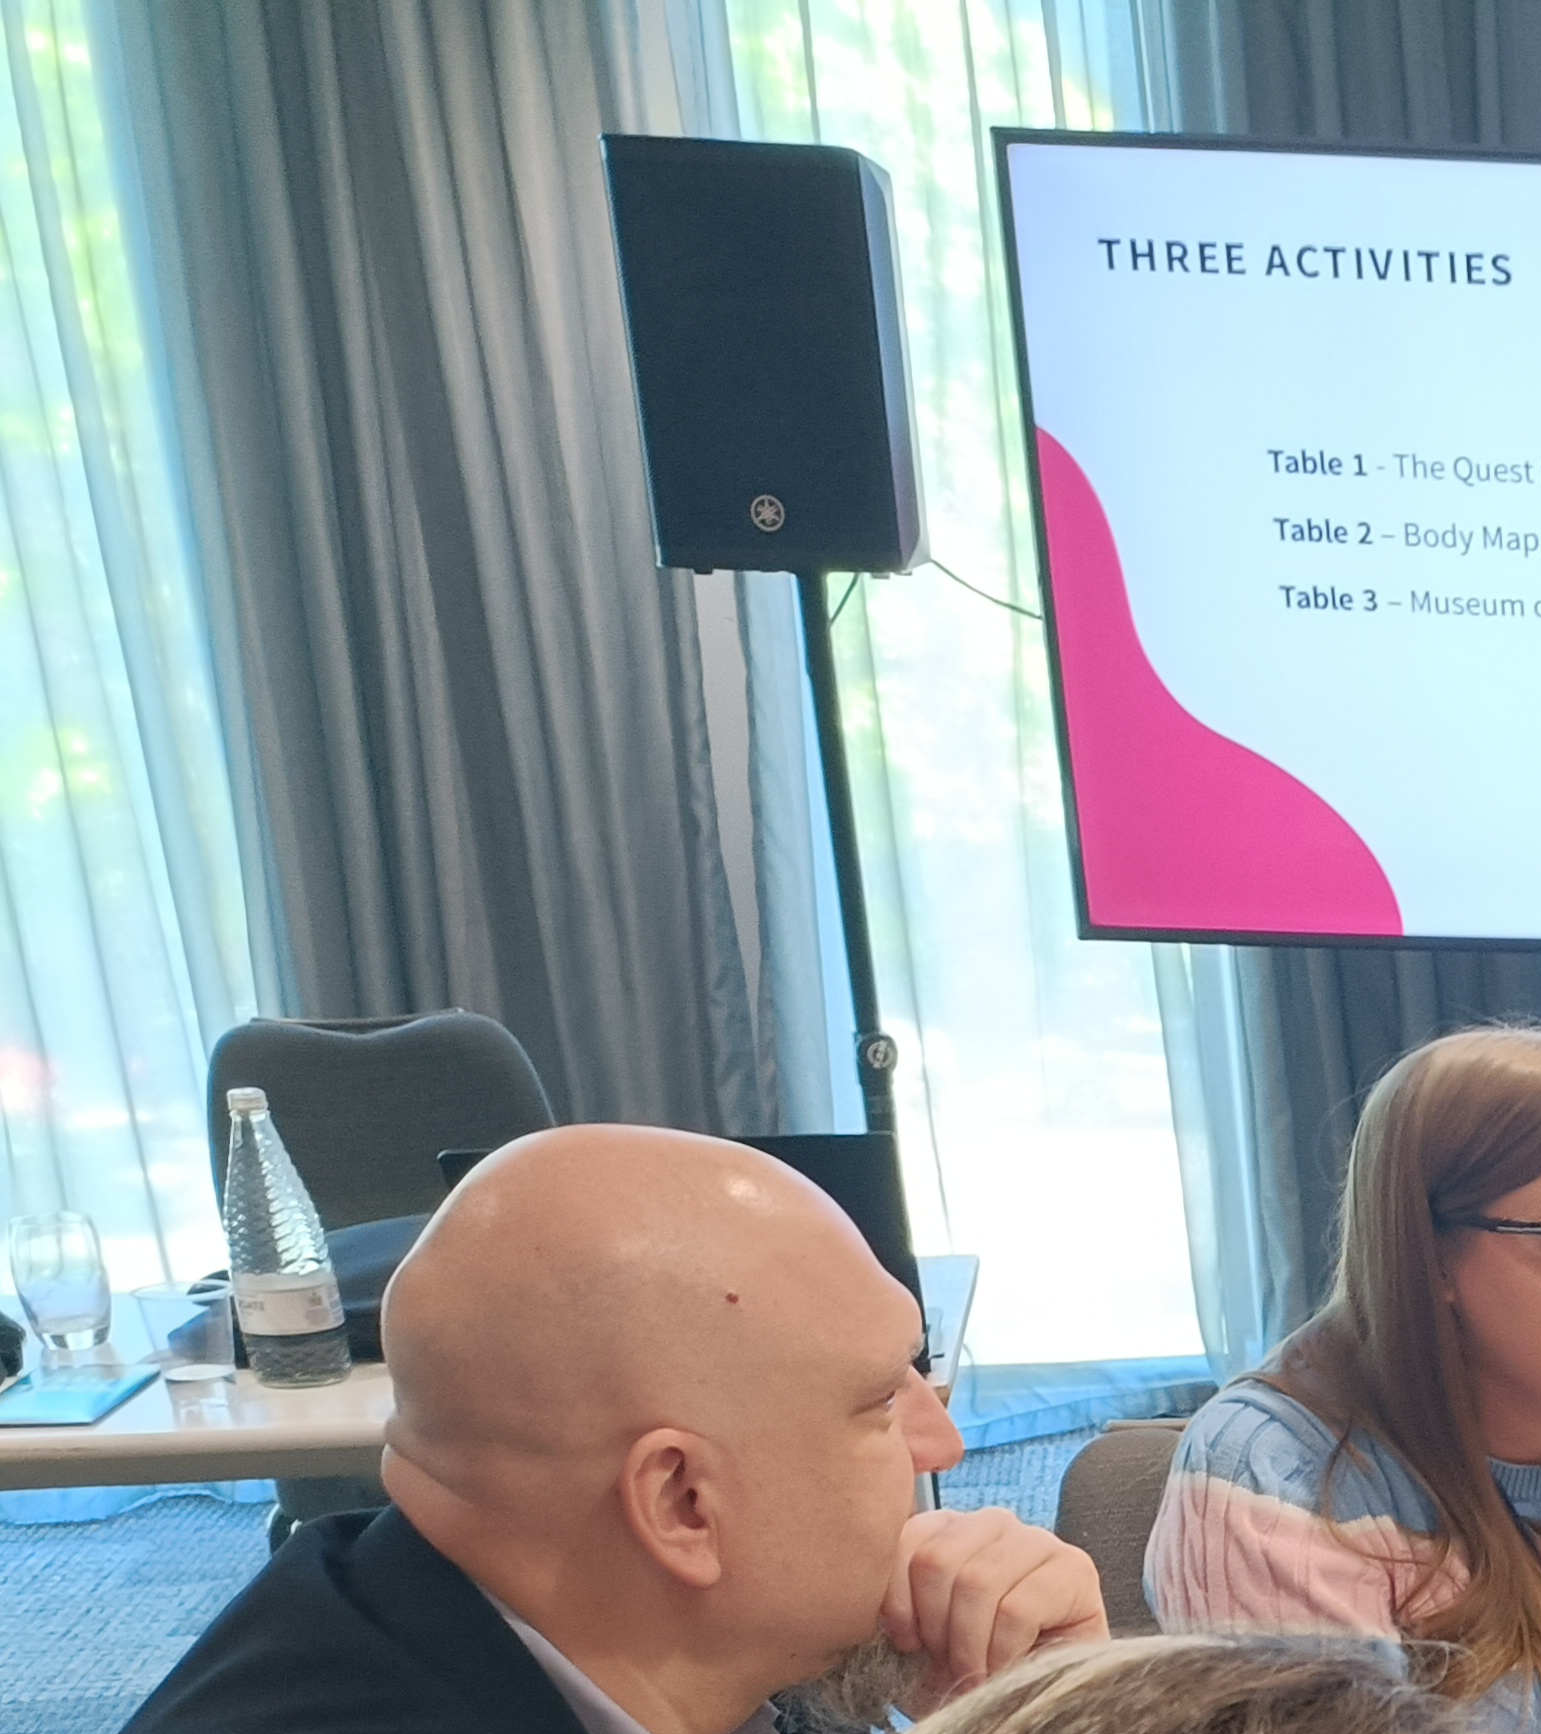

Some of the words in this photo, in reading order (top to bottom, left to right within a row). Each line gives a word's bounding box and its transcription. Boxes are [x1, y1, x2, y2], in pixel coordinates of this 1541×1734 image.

[1097, 238, 1247, 275] THREE
[1264, 243, 1513, 286] ACTIVITIES
[1267, 448, 1344, 476] Table
[1353, 453, 1369, 477] 1
[1392, 452, 1446, 481] The
[1452, 455, 1534, 488] Quest
[1272, 516, 1349, 545] Table
[1356, 521, 1375, 546] 2
[1403, 522, 1474, 557] Body
[1278, 584, 1354, 612] Table
[1362, 588, 1379, 613] 3
[1410, 589, 1526, 618] Museum
